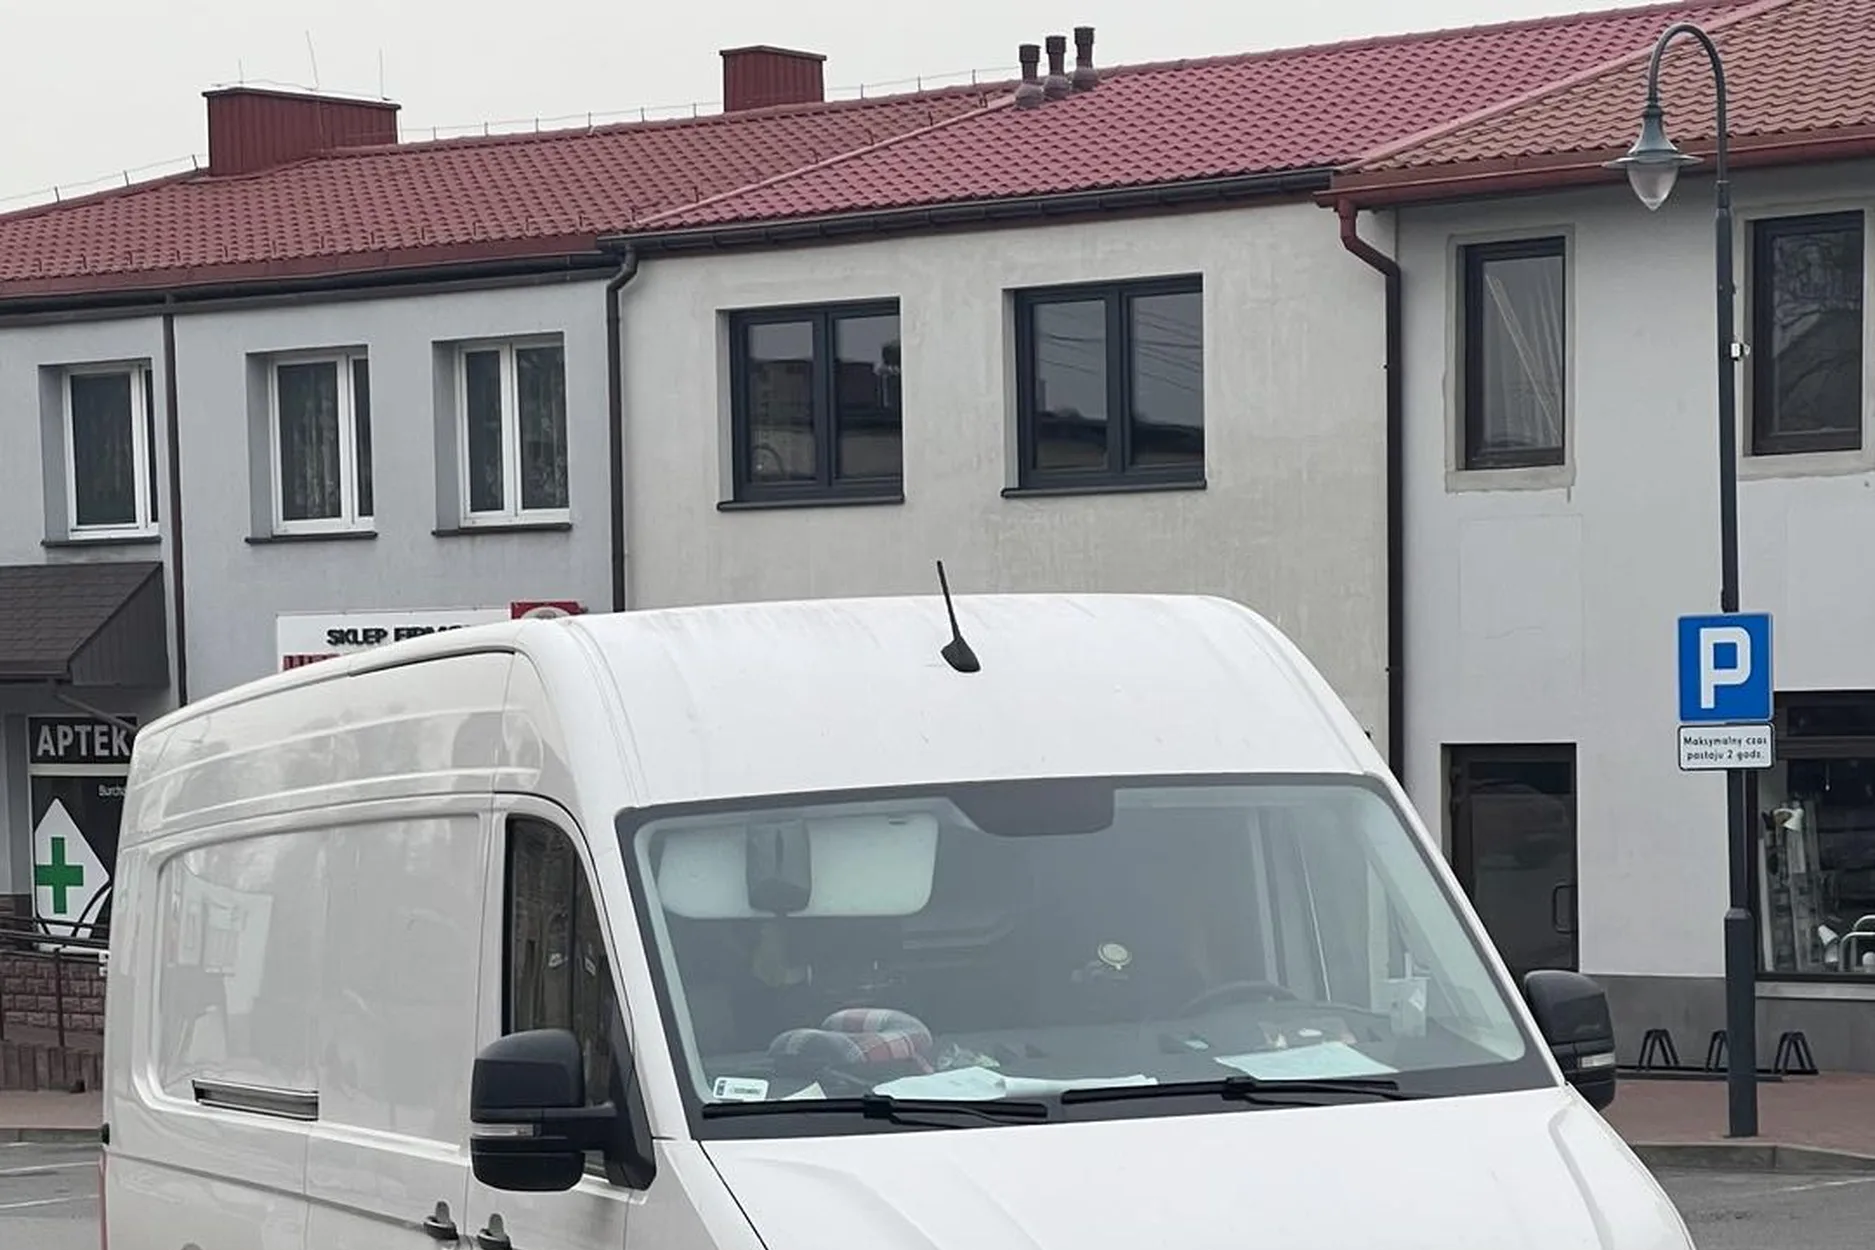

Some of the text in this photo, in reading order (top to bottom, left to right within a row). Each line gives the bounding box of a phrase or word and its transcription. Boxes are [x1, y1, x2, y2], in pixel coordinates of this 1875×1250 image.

[326, 628, 388, 646] SKLEP
[1700, 627, 1750, 709] P
[36, 725, 130, 756] APTEK
[1683, 736, 1767, 747] Maksymalny czas
[1687, 749, 1724, 761] postoju
[1727, 749, 1734, 758] 2
